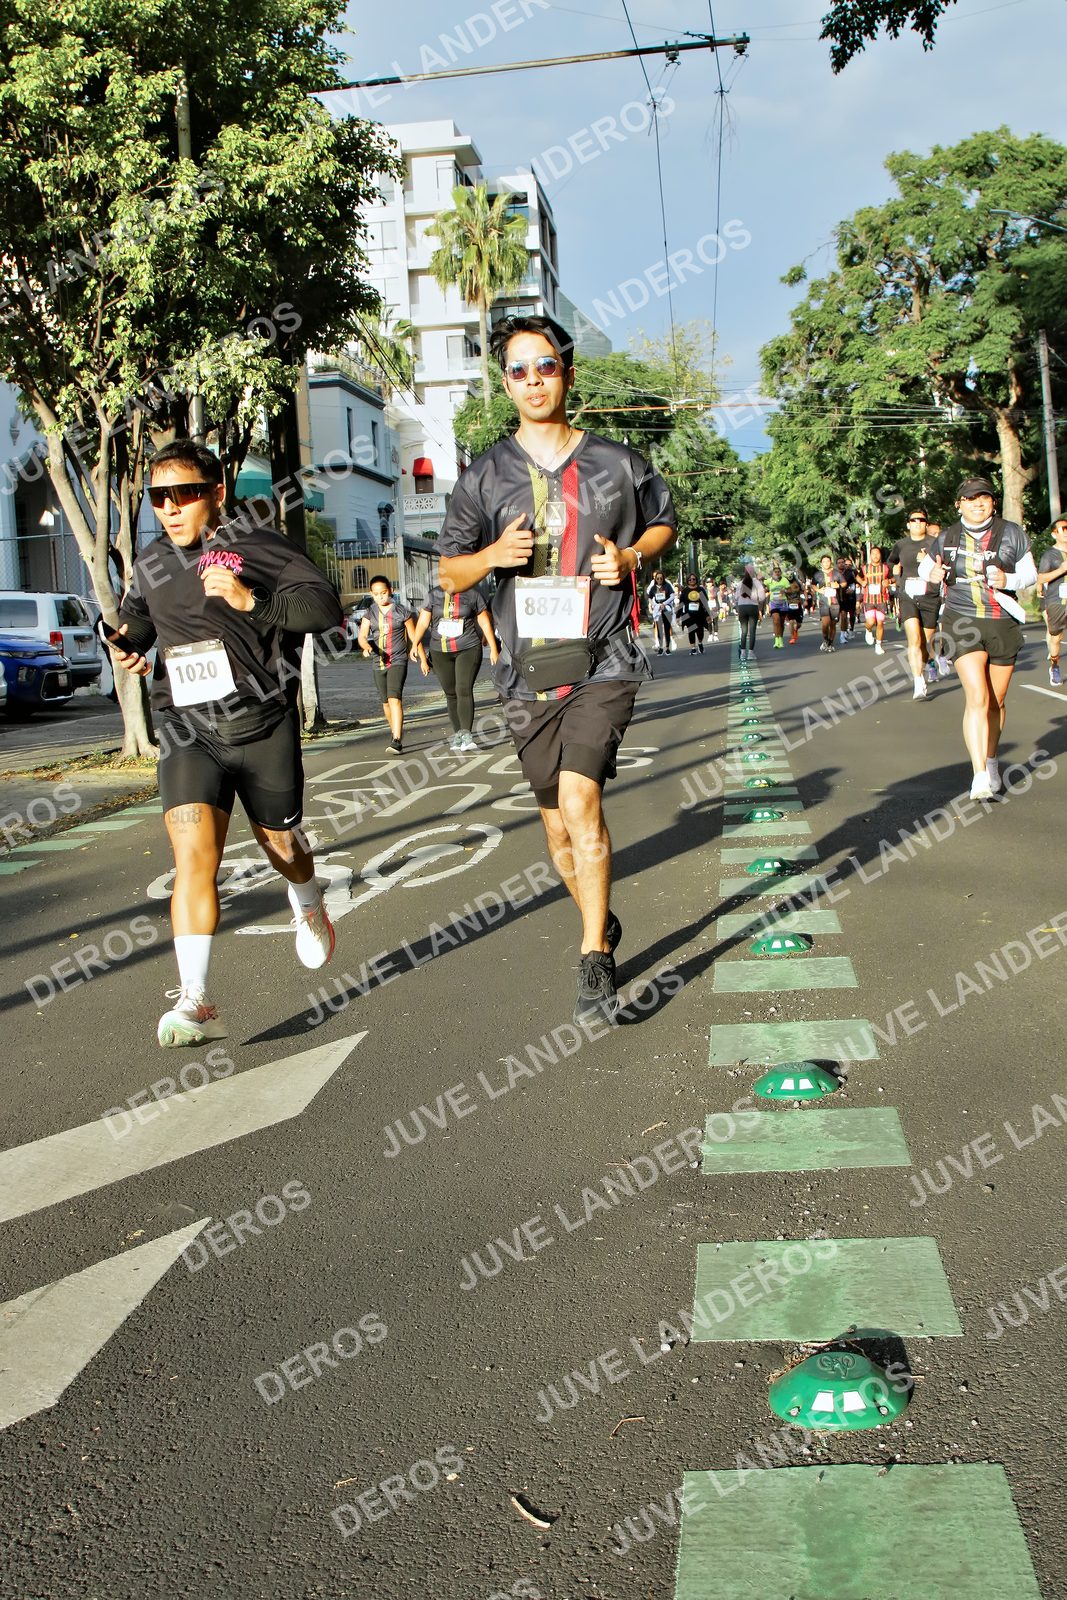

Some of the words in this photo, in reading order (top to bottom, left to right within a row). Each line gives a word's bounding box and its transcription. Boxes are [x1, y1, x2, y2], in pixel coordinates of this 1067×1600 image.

[197, 550, 244, 573] PARADISE
[524, 597, 574, 616] 8874
[176, 660, 218, 684] 1020
